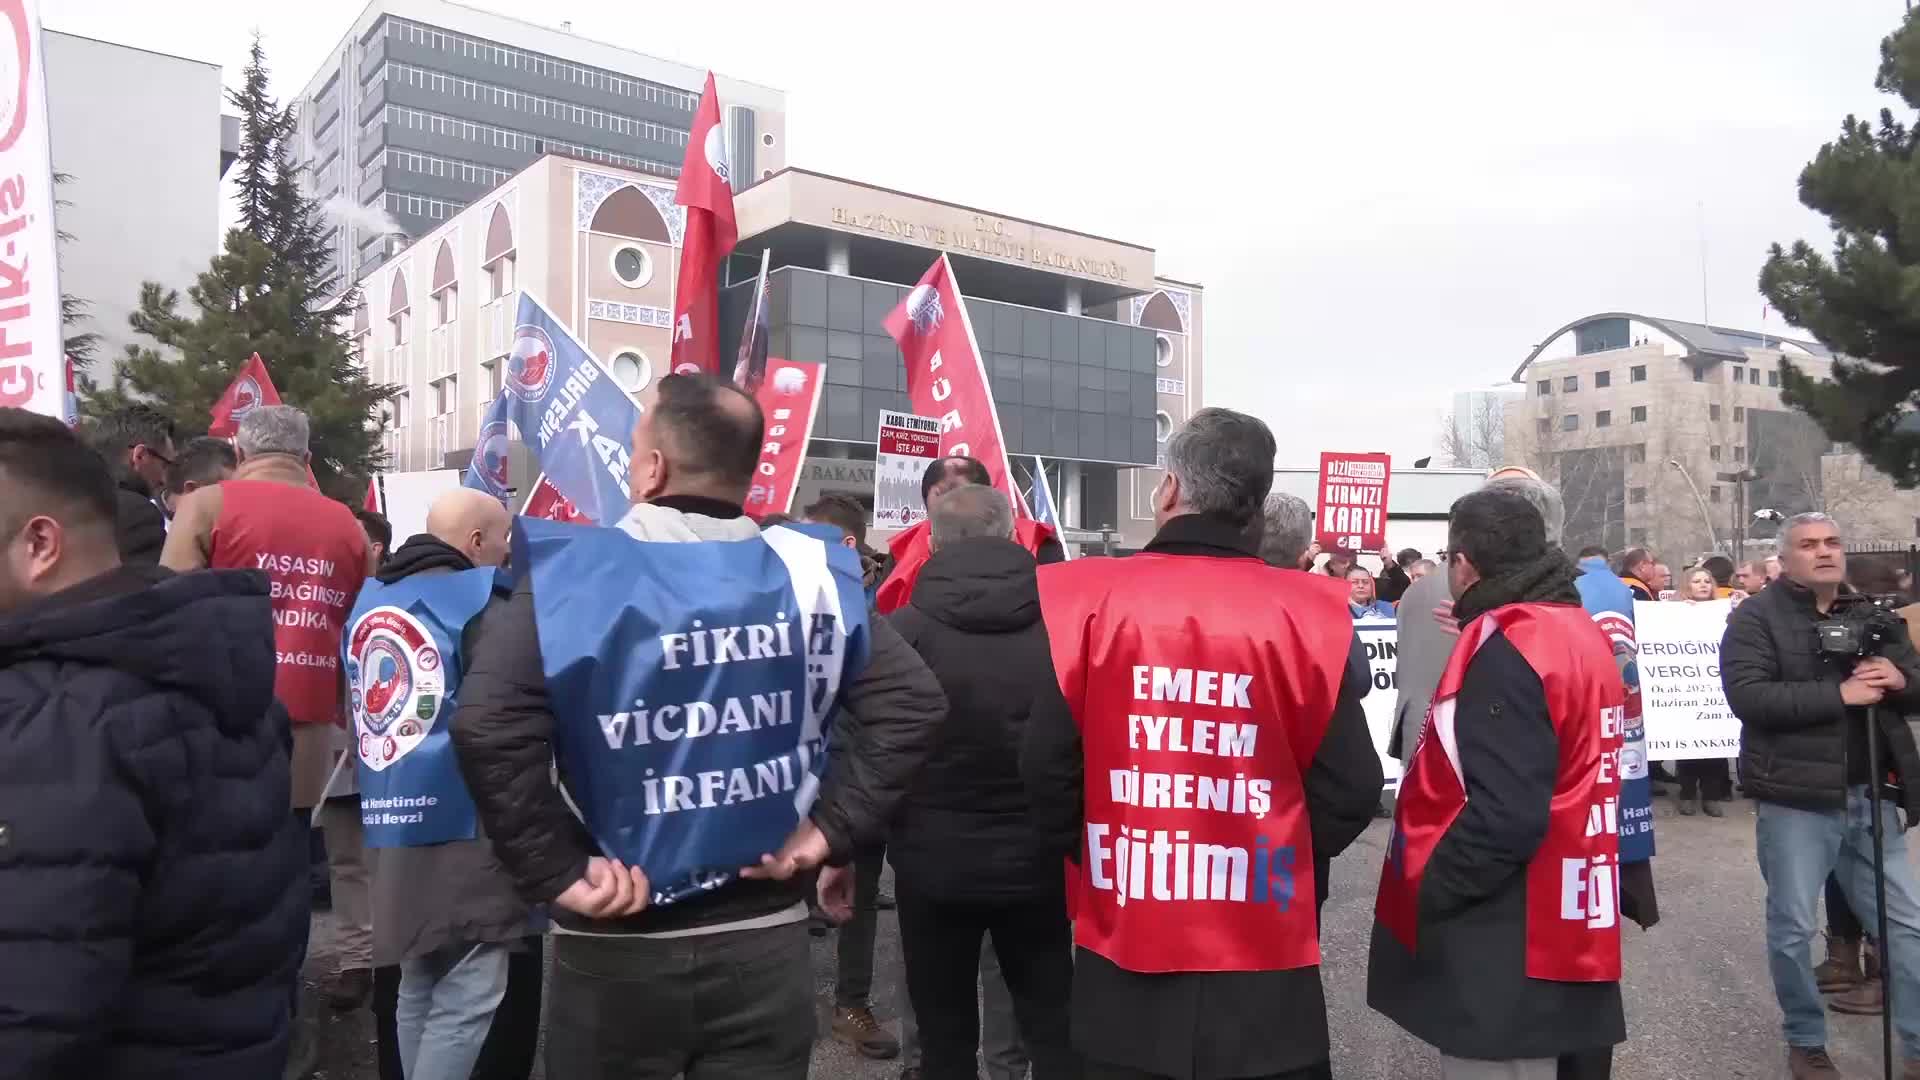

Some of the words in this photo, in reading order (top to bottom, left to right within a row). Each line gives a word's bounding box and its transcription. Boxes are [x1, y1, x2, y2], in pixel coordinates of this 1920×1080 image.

[831, 207, 914, 238] HAZİNE
[922, 226, 945, 245] VE
[951, 231, 1026, 260] MALİYE
[1031, 249, 1129, 281] BAKANLIĞI
[886, 414, 905, 428] KABUL
[911, 444, 925, 453] AKP
[1325, 484, 1383, 505] KIRMIZI
[1324, 506, 1381, 535] KART!
[255, 553, 335, 577] YAŞASIN
[271, 607, 328, 631] NDİKA
[660, 611, 793, 671] FİKRİ
[1132, 665, 1254, 708] EMEK
[1651, 698, 1698, 708] Haziran
[1703, 697, 1724, 707] 202
[597, 690, 793, 750] VİCDANI
[1696, 711, 1722, 720] Zam
[1128, 714, 1258, 758] EYLEM
[642, 756, 795, 815] İRFANI
[1109, 765, 1272, 820] DİRENİŞ
[1086, 822, 1249, 908] Eğitim
